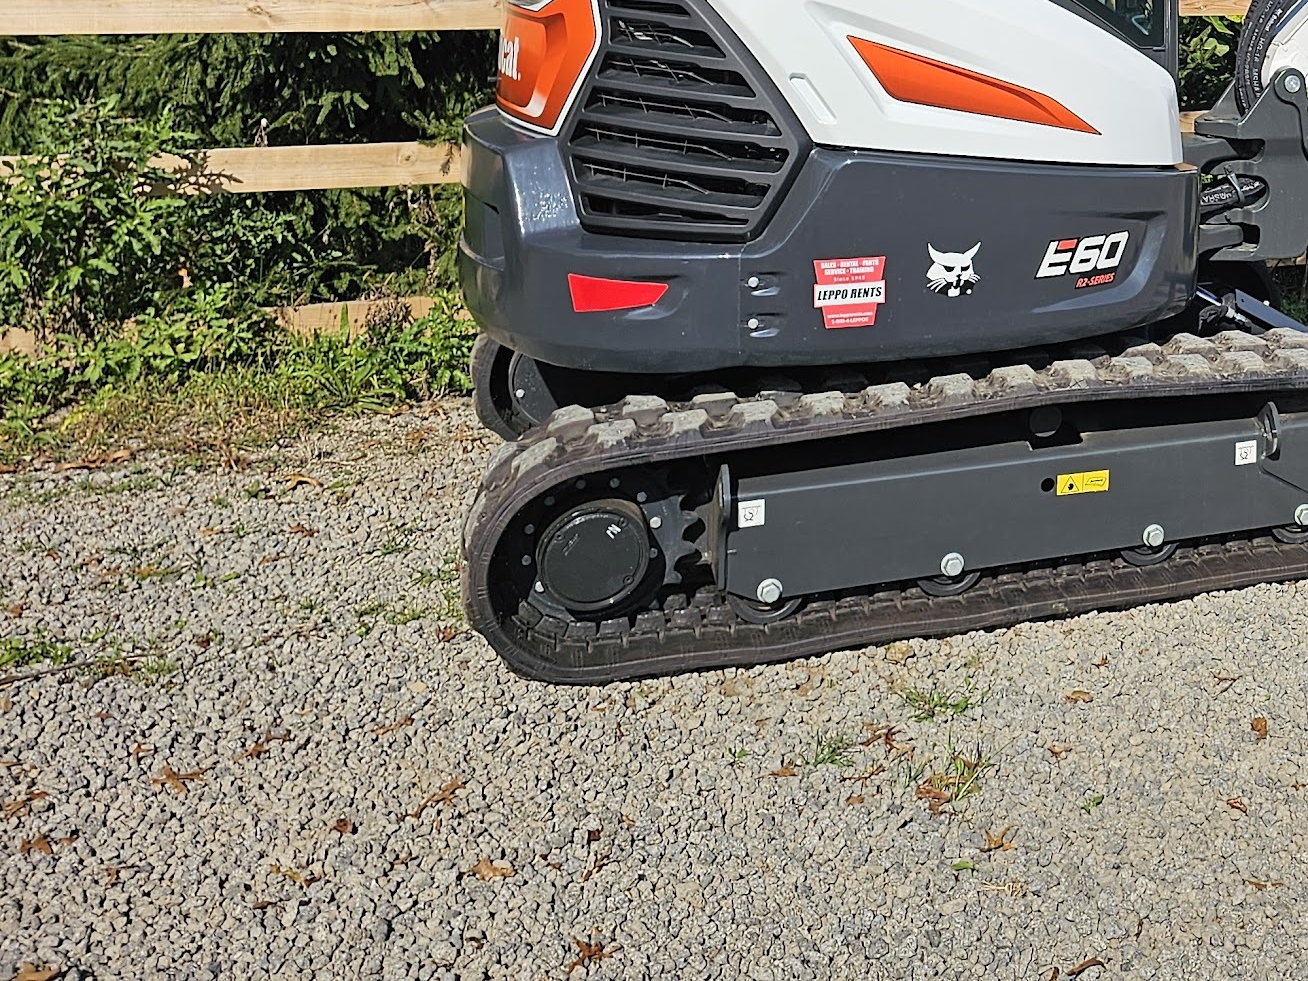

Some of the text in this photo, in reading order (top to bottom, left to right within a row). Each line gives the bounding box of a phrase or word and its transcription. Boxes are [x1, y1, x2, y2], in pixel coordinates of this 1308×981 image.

[498, 35, 519, 81] cat
[1036, 230, 1129, 278] E60
[817, 286, 882, 301] LEPPO RENTS
[1075, 272, 1115, 288] R2-SERIES
